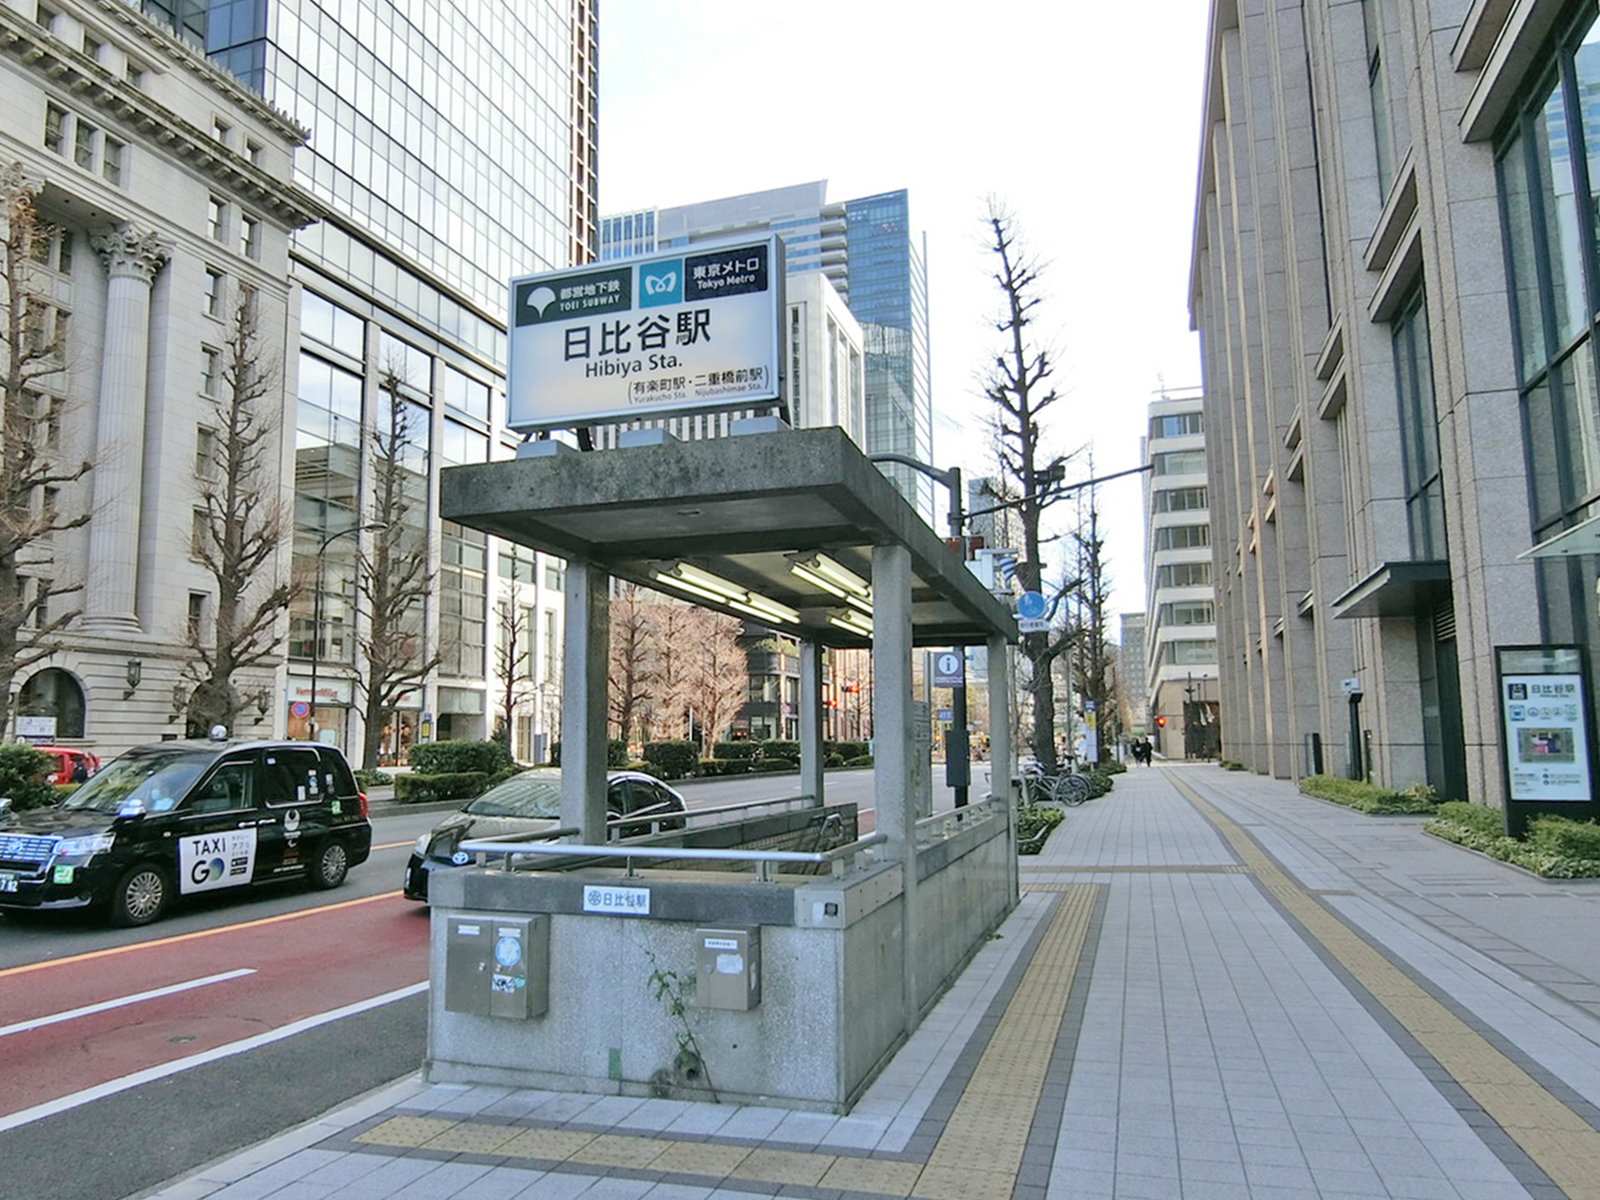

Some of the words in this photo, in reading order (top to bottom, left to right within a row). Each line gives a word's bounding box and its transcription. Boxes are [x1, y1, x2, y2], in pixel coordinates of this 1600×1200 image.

[692, 257, 759, 279] 東京メトロ
[560, 280, 620, 300] 都営地下鉄
[697, 279, 725, 290] Tokyo
[726, 274, 755, 285] Metro
[560, 302, 580, 312] TOEI
[582, 295, 621, 308] SUBWAY
[565, 308, 711, 361] 日比谷駅
[585, 358, 642, 379] Hibiya
[649, 353, 683, 371] Sta.
[634, 393, 672, 404] Yurakucho
[695, 385, 746, 397] Nijubashimae
[1531, 683, 1575, 694] 日比谷駅
[192, 838, 226, 856] TAXI
[191, 857, 225, 885] GO
[603, 891, 647, 908] 日比谷駅
